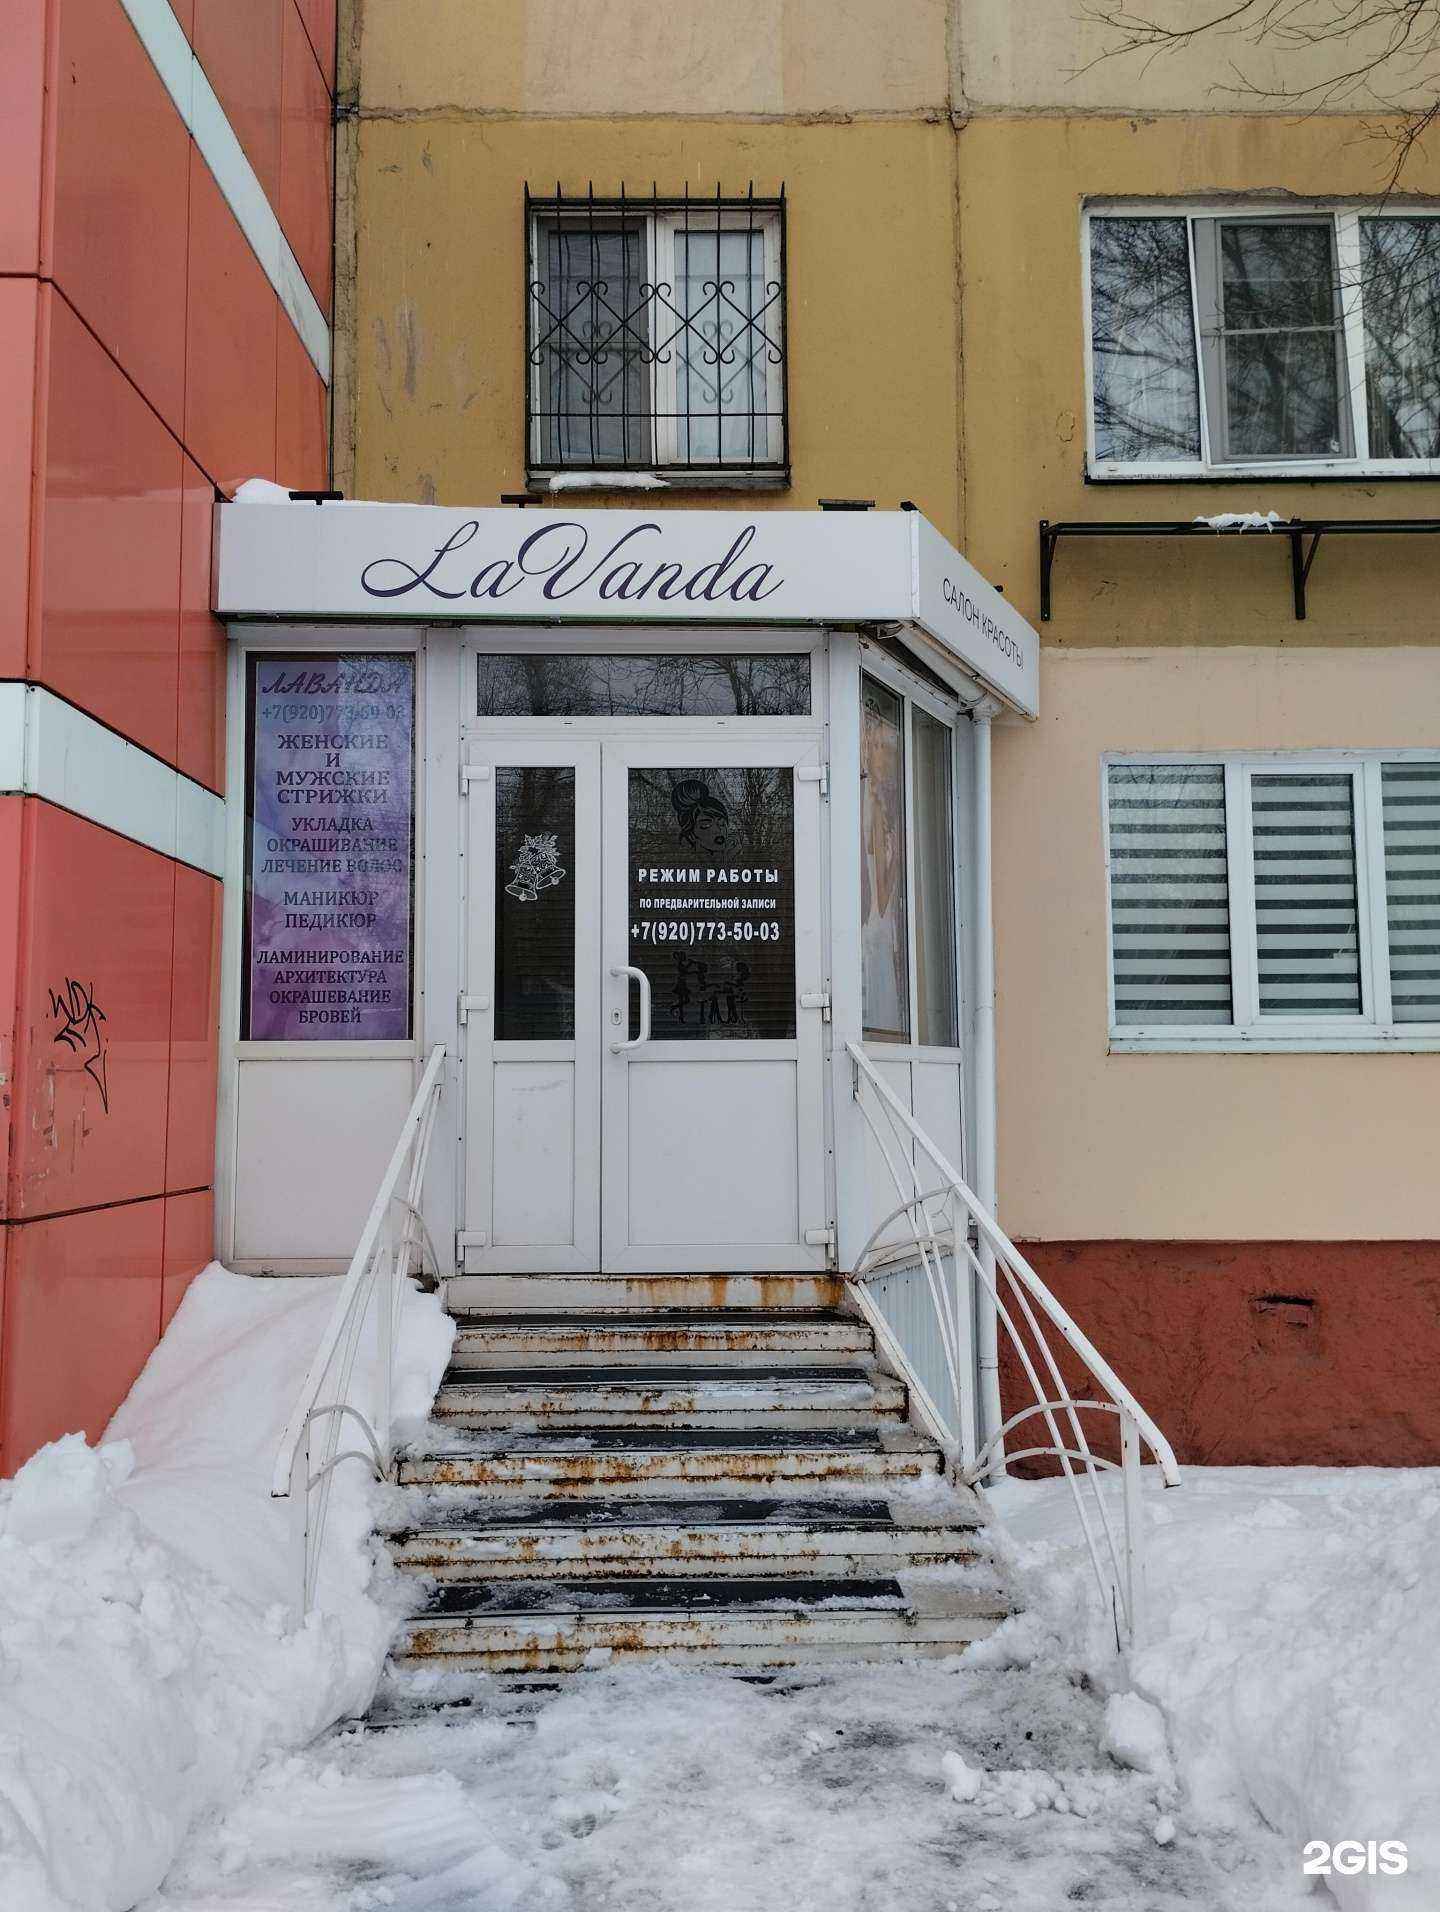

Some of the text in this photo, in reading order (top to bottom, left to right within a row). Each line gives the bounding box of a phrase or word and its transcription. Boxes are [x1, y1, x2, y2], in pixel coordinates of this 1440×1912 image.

[361, 520, 785, 602] LaVanda
[943, 578, 1024, 672] САЛОН КРАСОТЫ
[278, 734, 389, 750] ЖЕНСКИЕ
[325, 752, 341, 768] И
[275, 770, 391, 786] МУЖСКИЕ
[277, 789, 388, 804] СТРИЖКИ
[291, 817, 374, 834] УКЛАДКА
[261, 859, 342, 873] ЛЕЧЕНИЕ
[638, 868, 779, 883] РЕЖИМ РАБОТЫ
[284, 890, 380, 906] МАНИКЮР
[639, 896, 776, 911] ПО ПРЕДВАРИТЕЛЬНОЙ ЗАПИСИ
[285, 913, 377, 931] ПЕДИКЮР
[631, 921, 780, 945] +7(920)773-50-03
[256, 950, 405, 964] ЛАМИНИРОВАНИЕ
[273, 969, 388, 984] АРХИТЕКТУРА
[269, 989, 392, 1004] ОКРАШЕВАНИЕ
[299, 1007, 362, 1024] БРОВЕЙ
